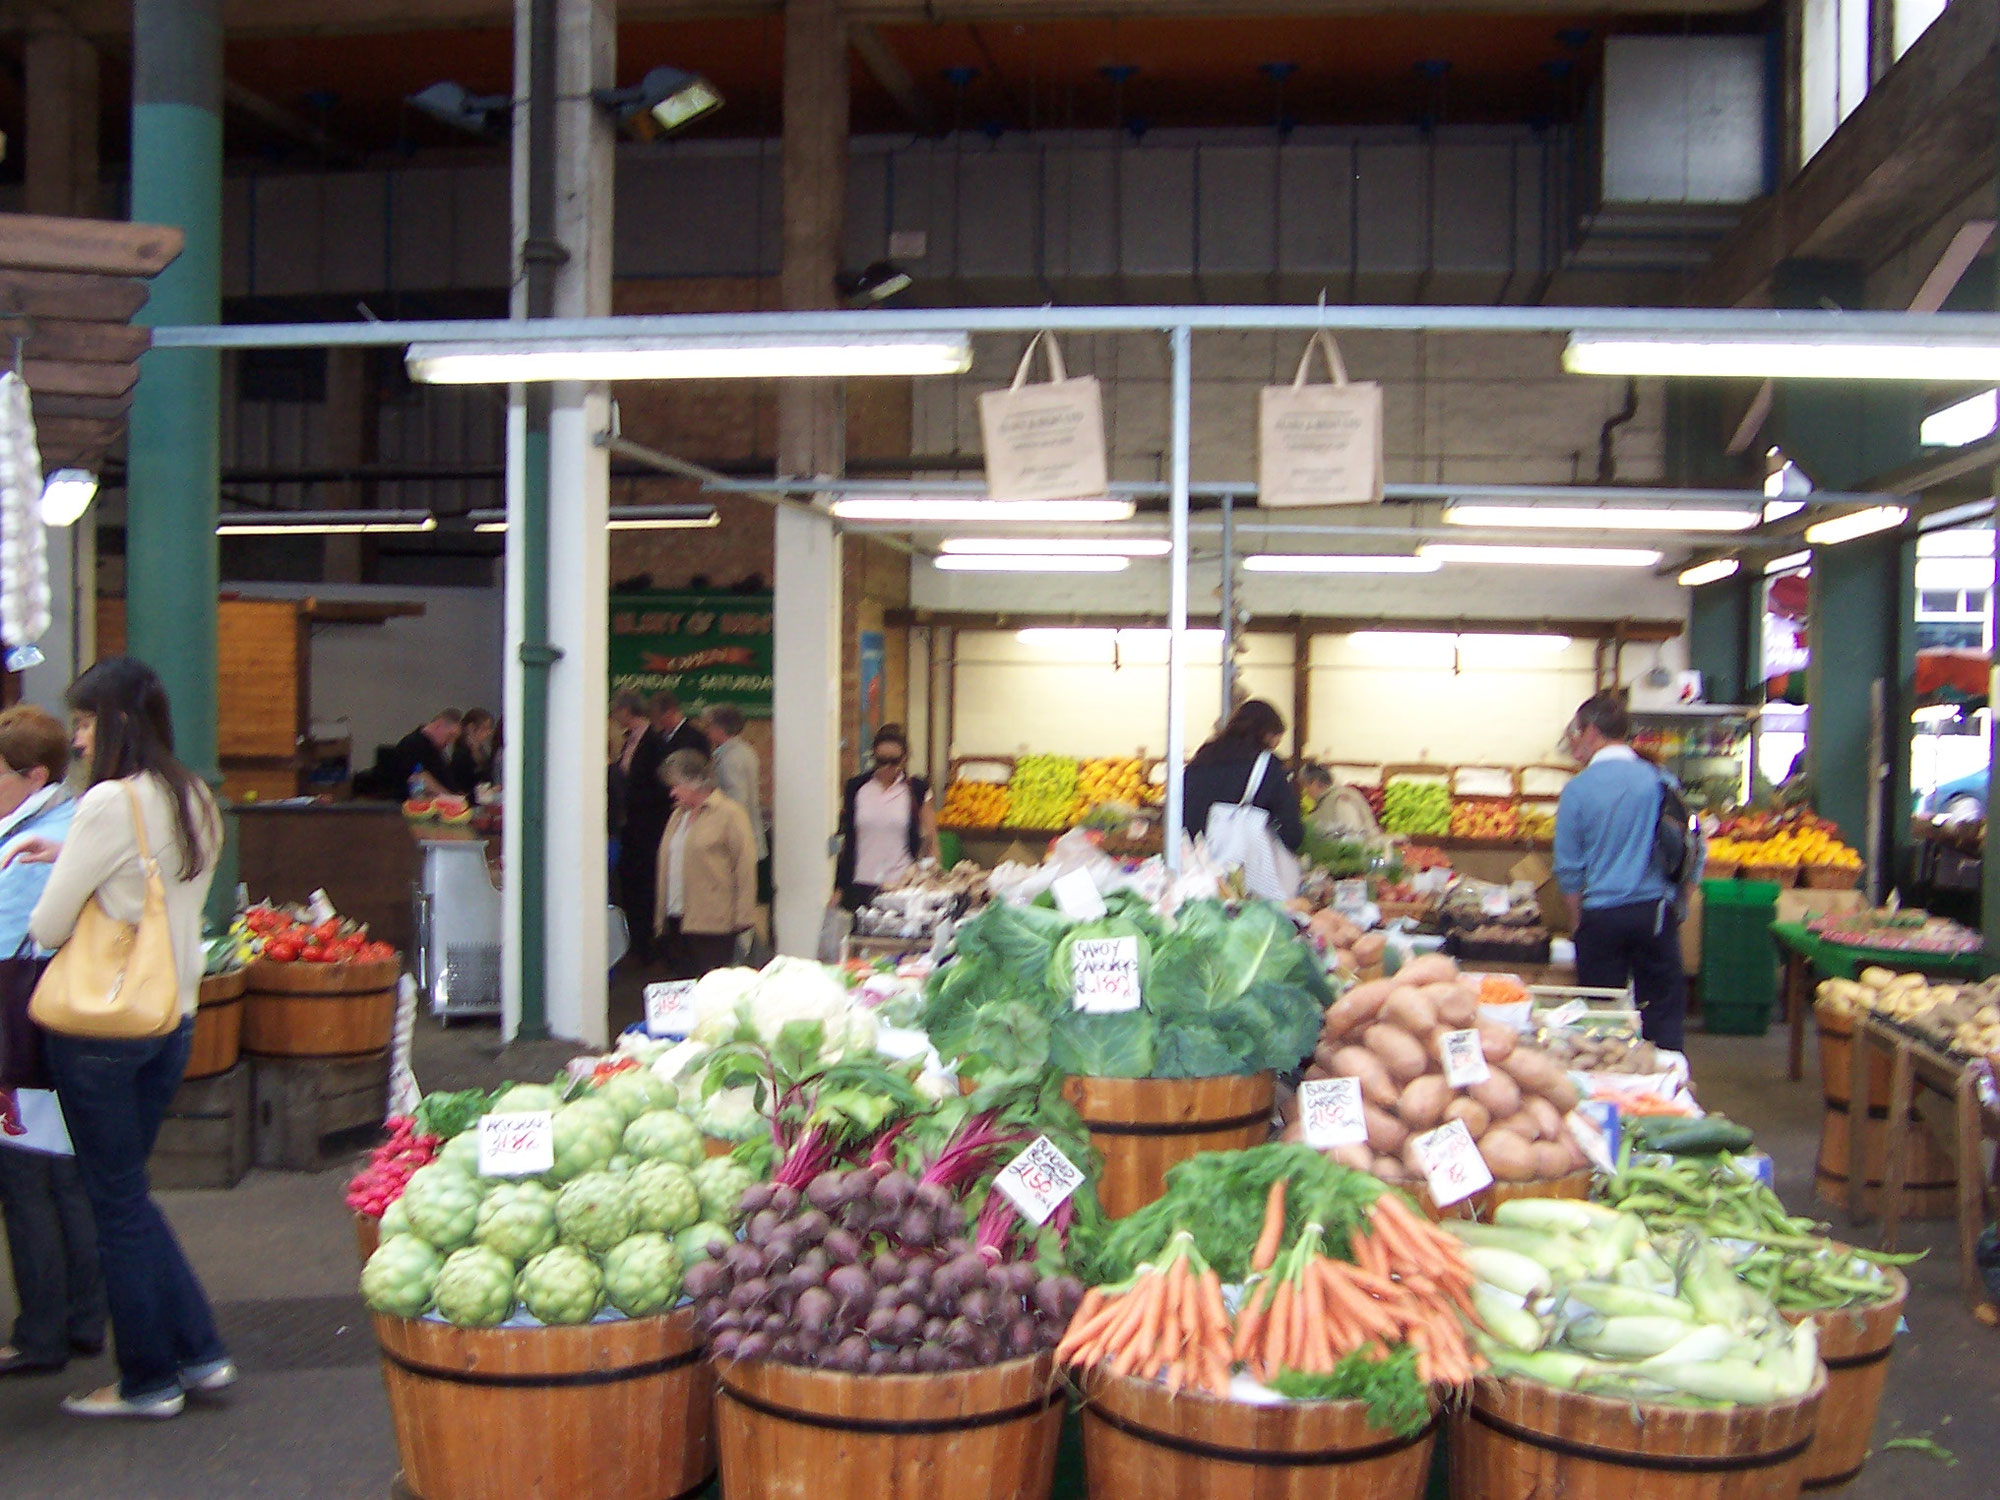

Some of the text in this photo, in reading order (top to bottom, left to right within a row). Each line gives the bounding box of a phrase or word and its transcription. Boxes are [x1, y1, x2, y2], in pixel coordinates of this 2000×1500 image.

[613, 673, 684, 690] MONDAY
[700, 673, 774, 691] SATURDA
[1077, 940, 1121, 961] SAVOY
